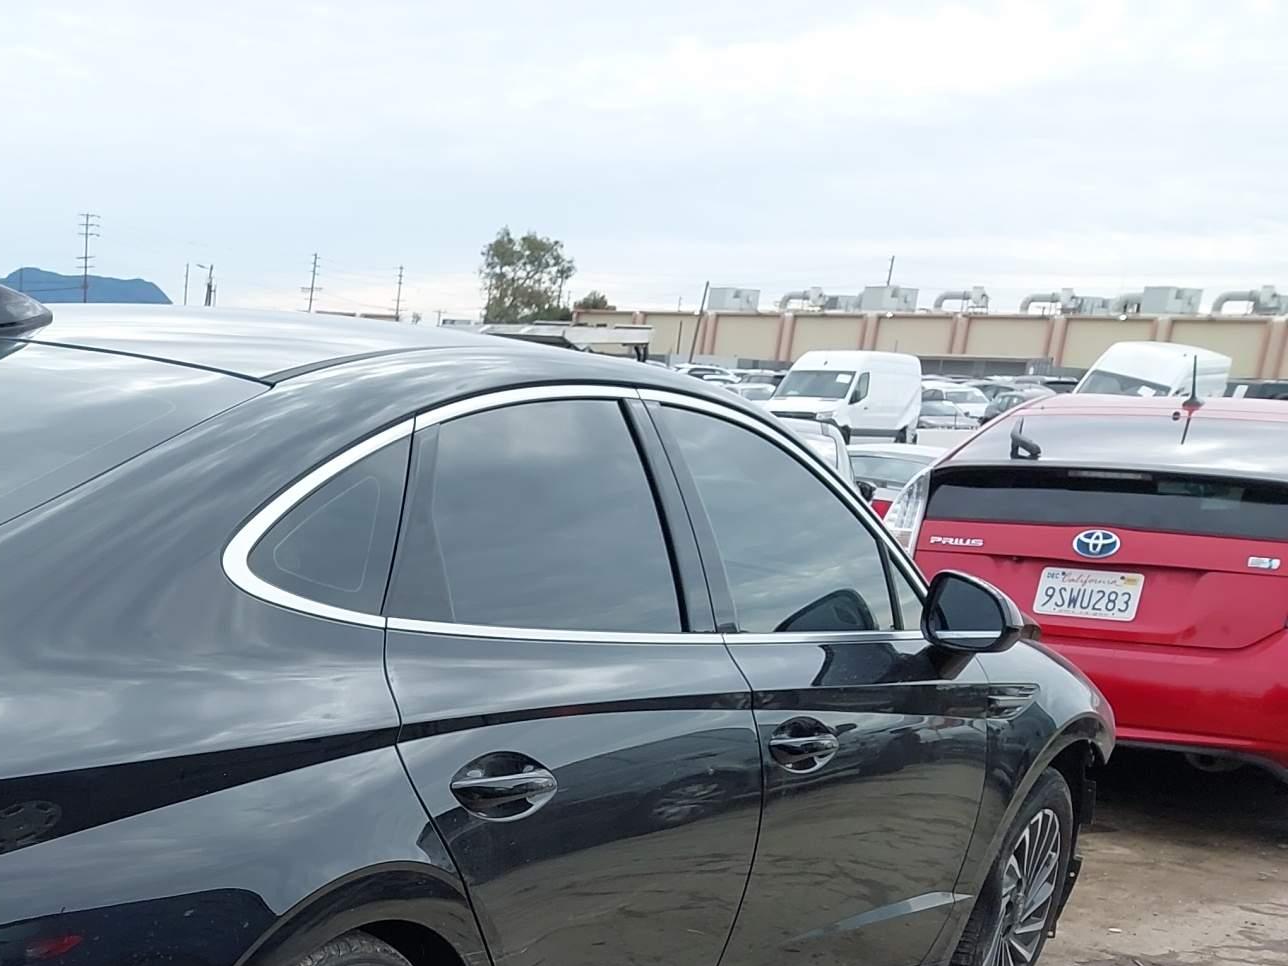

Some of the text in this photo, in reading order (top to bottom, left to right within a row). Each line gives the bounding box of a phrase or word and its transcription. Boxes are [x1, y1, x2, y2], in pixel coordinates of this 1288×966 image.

[929, 535, 984, 547] PRIUS
[1062, 571, 1121, 587] California
[1040, 585, 1132, 613] 9SWU283
